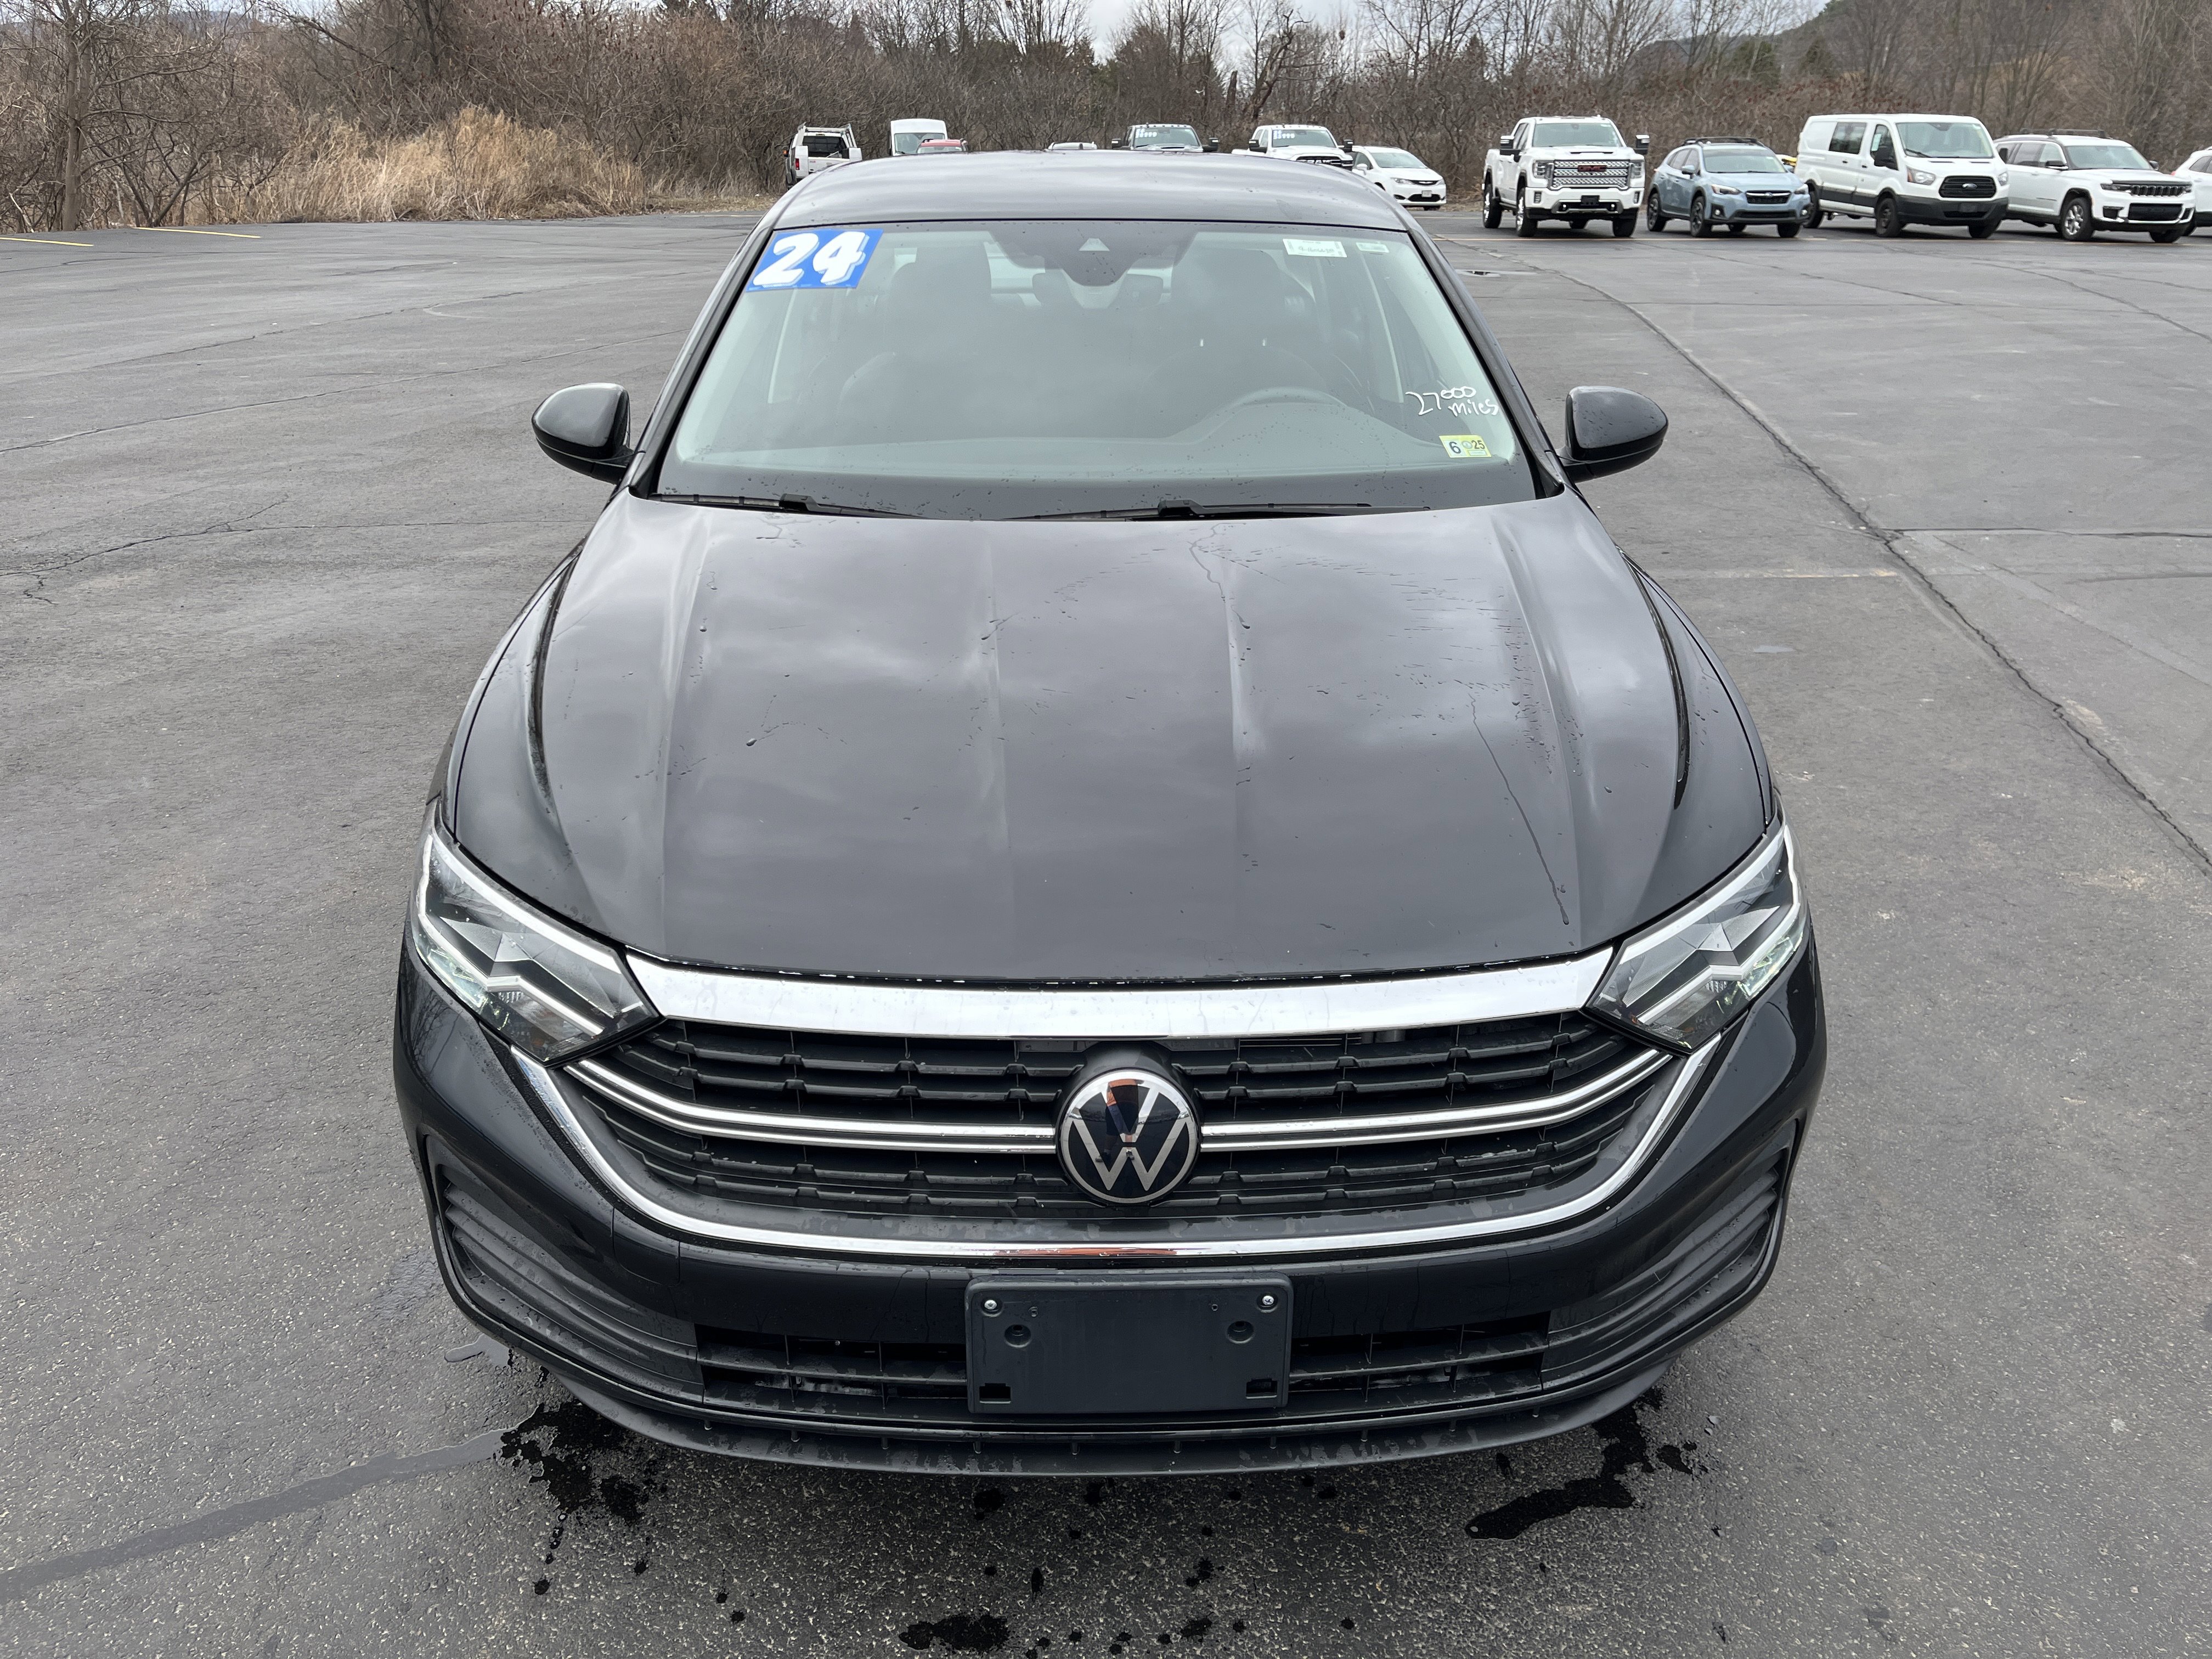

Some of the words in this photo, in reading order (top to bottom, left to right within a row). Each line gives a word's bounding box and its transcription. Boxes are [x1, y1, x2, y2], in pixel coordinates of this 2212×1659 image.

[753, 231, 870, 288] 24
[1448, 399, 1499, 417] miles
[1449, 441, 1462, 454] 6
[1471, 440, 1485, 450] 25
[1066, 1076, 1192, 1193] VW
